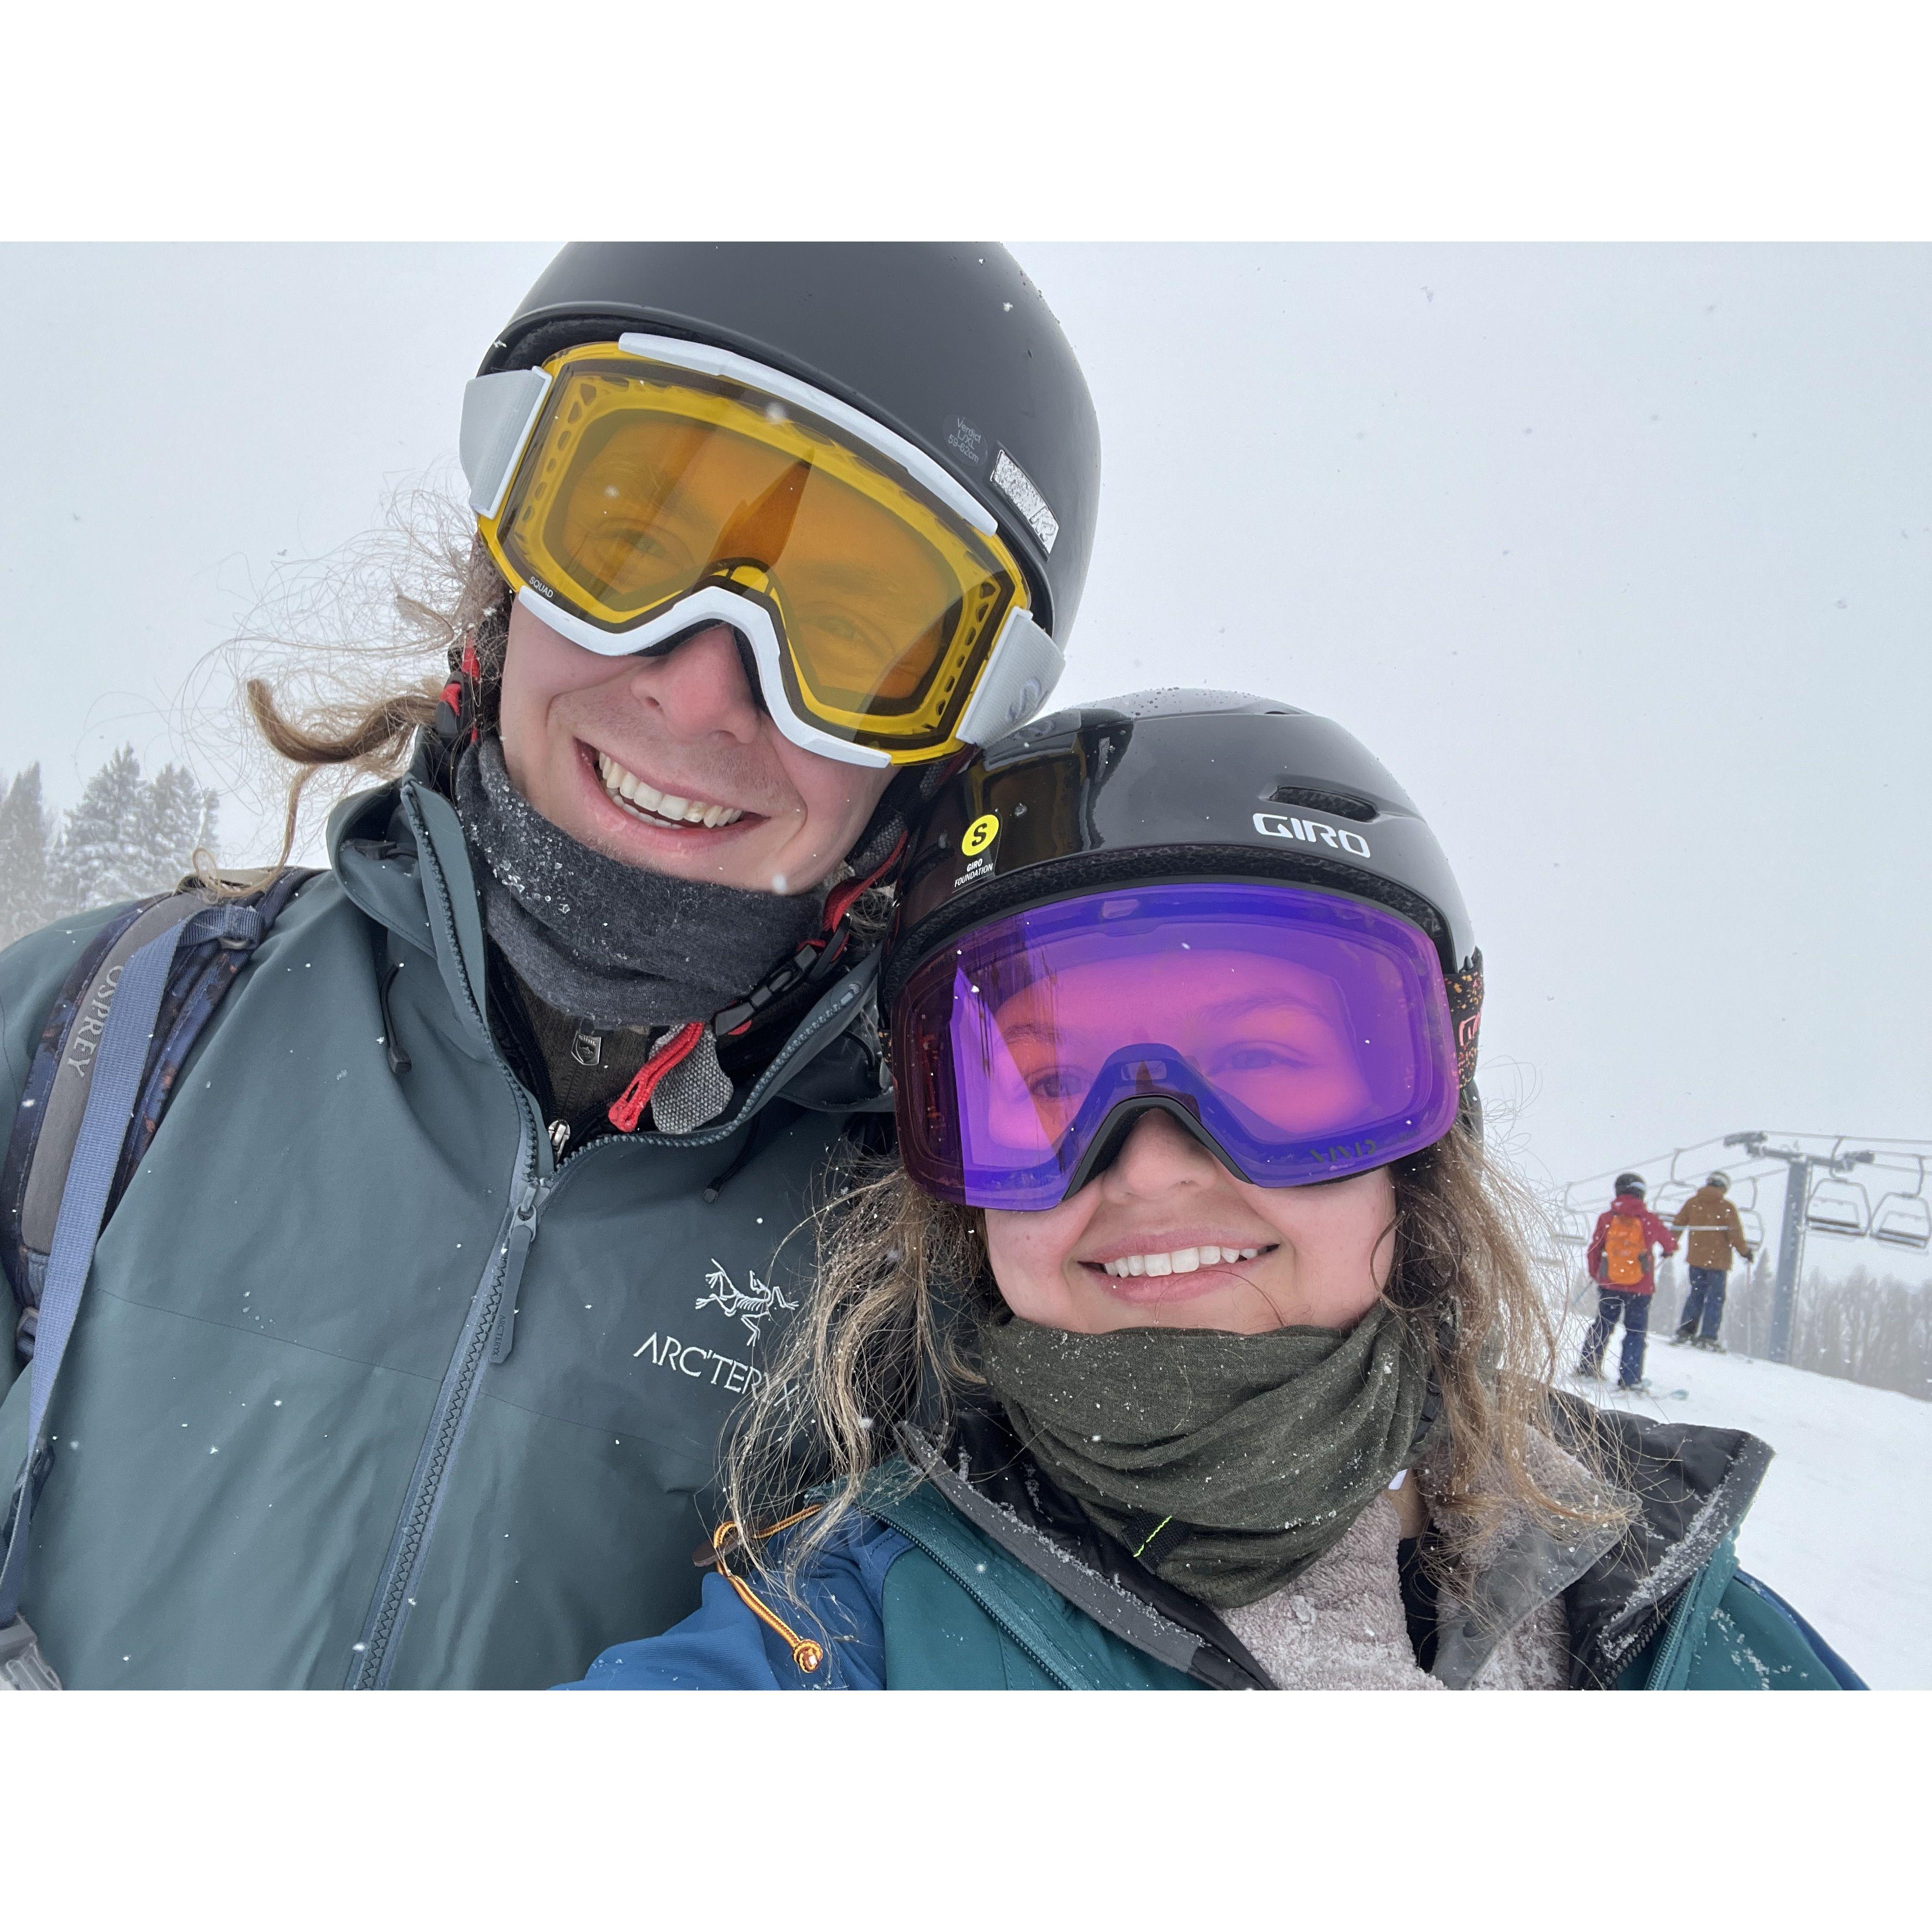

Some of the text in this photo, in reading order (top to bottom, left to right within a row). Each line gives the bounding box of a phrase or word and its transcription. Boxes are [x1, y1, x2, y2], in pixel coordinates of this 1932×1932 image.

[958, 418, 981, 444] Verdict
[529, 576, 553, 598] SQUAD
[972, 823, 988, 847] S
[1253, 813, 1370, 858] GIRO
[954, 863, 993, 887] FOUNDATION
[966, 858, 983, 872] GIRO
[67, 965, 125, 1078] OSPREY
